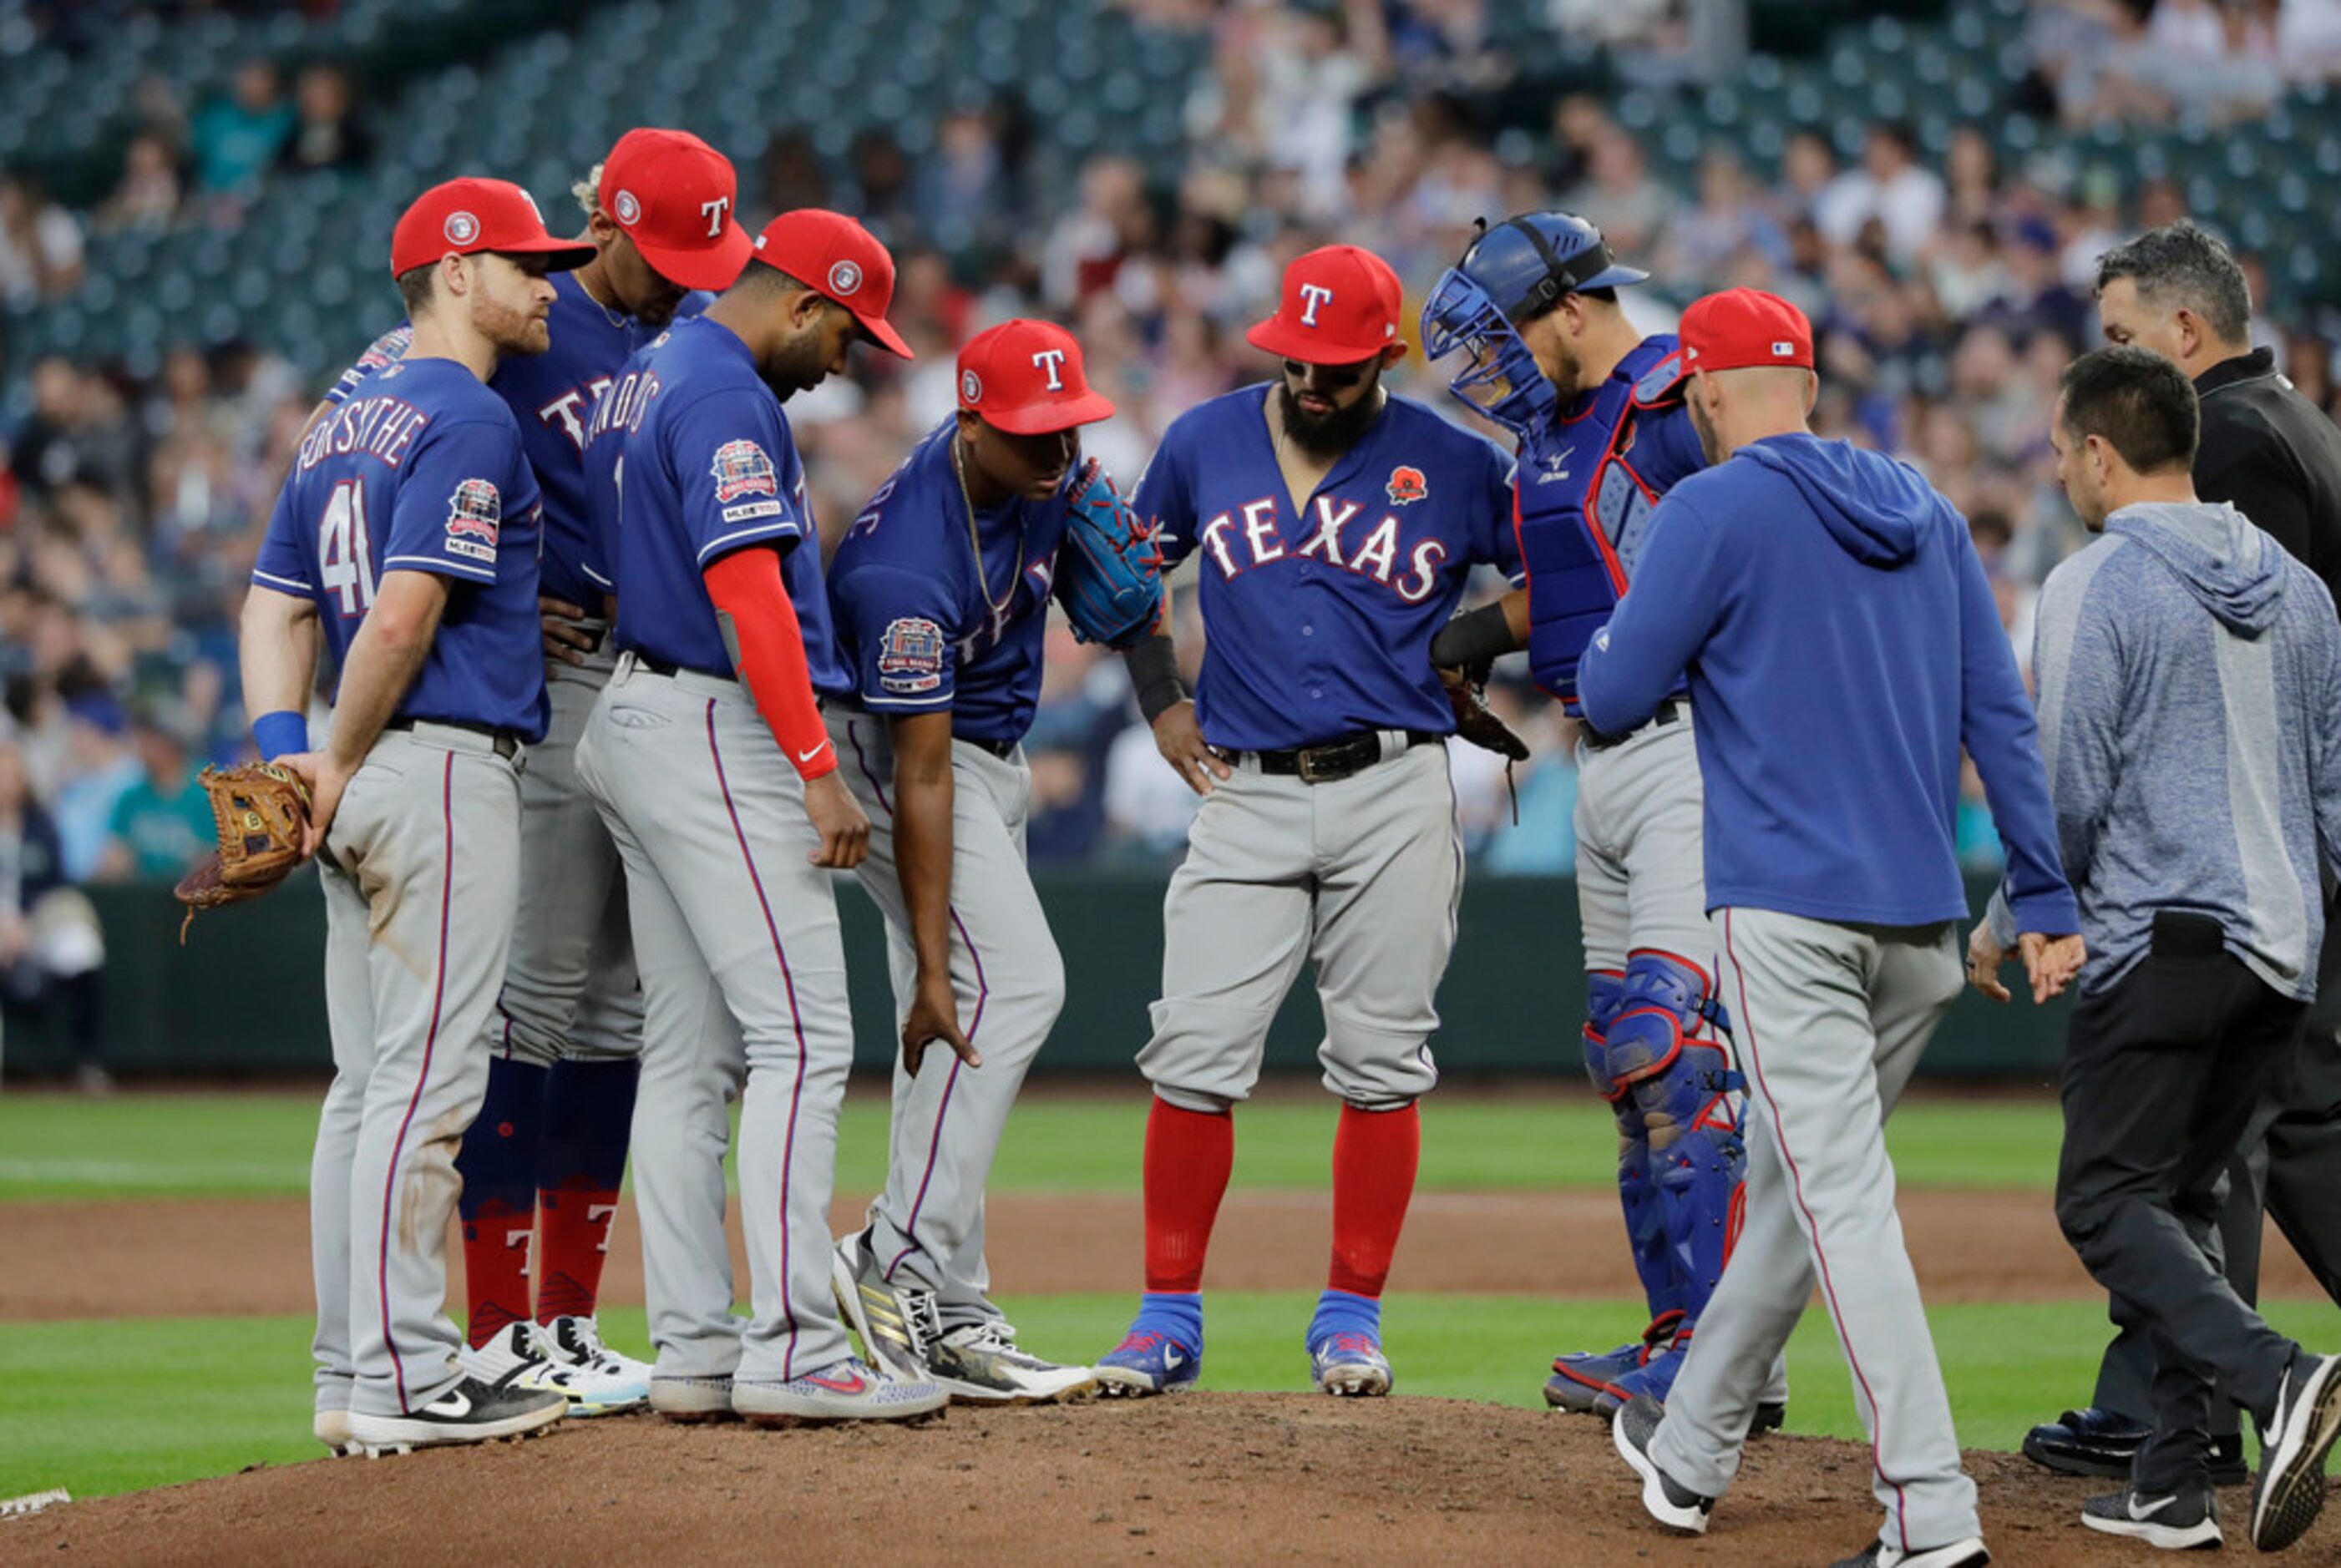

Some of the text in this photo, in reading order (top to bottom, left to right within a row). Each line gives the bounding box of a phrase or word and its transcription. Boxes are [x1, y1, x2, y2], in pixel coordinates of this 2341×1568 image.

[701, 196, 728, 237] T
[1300, 283, 1333, 327] T
[1032, 349, 1065, 392] T
[319, 475, 376, 618] 41
[1201, 493, 1447, 604] TEXAS
